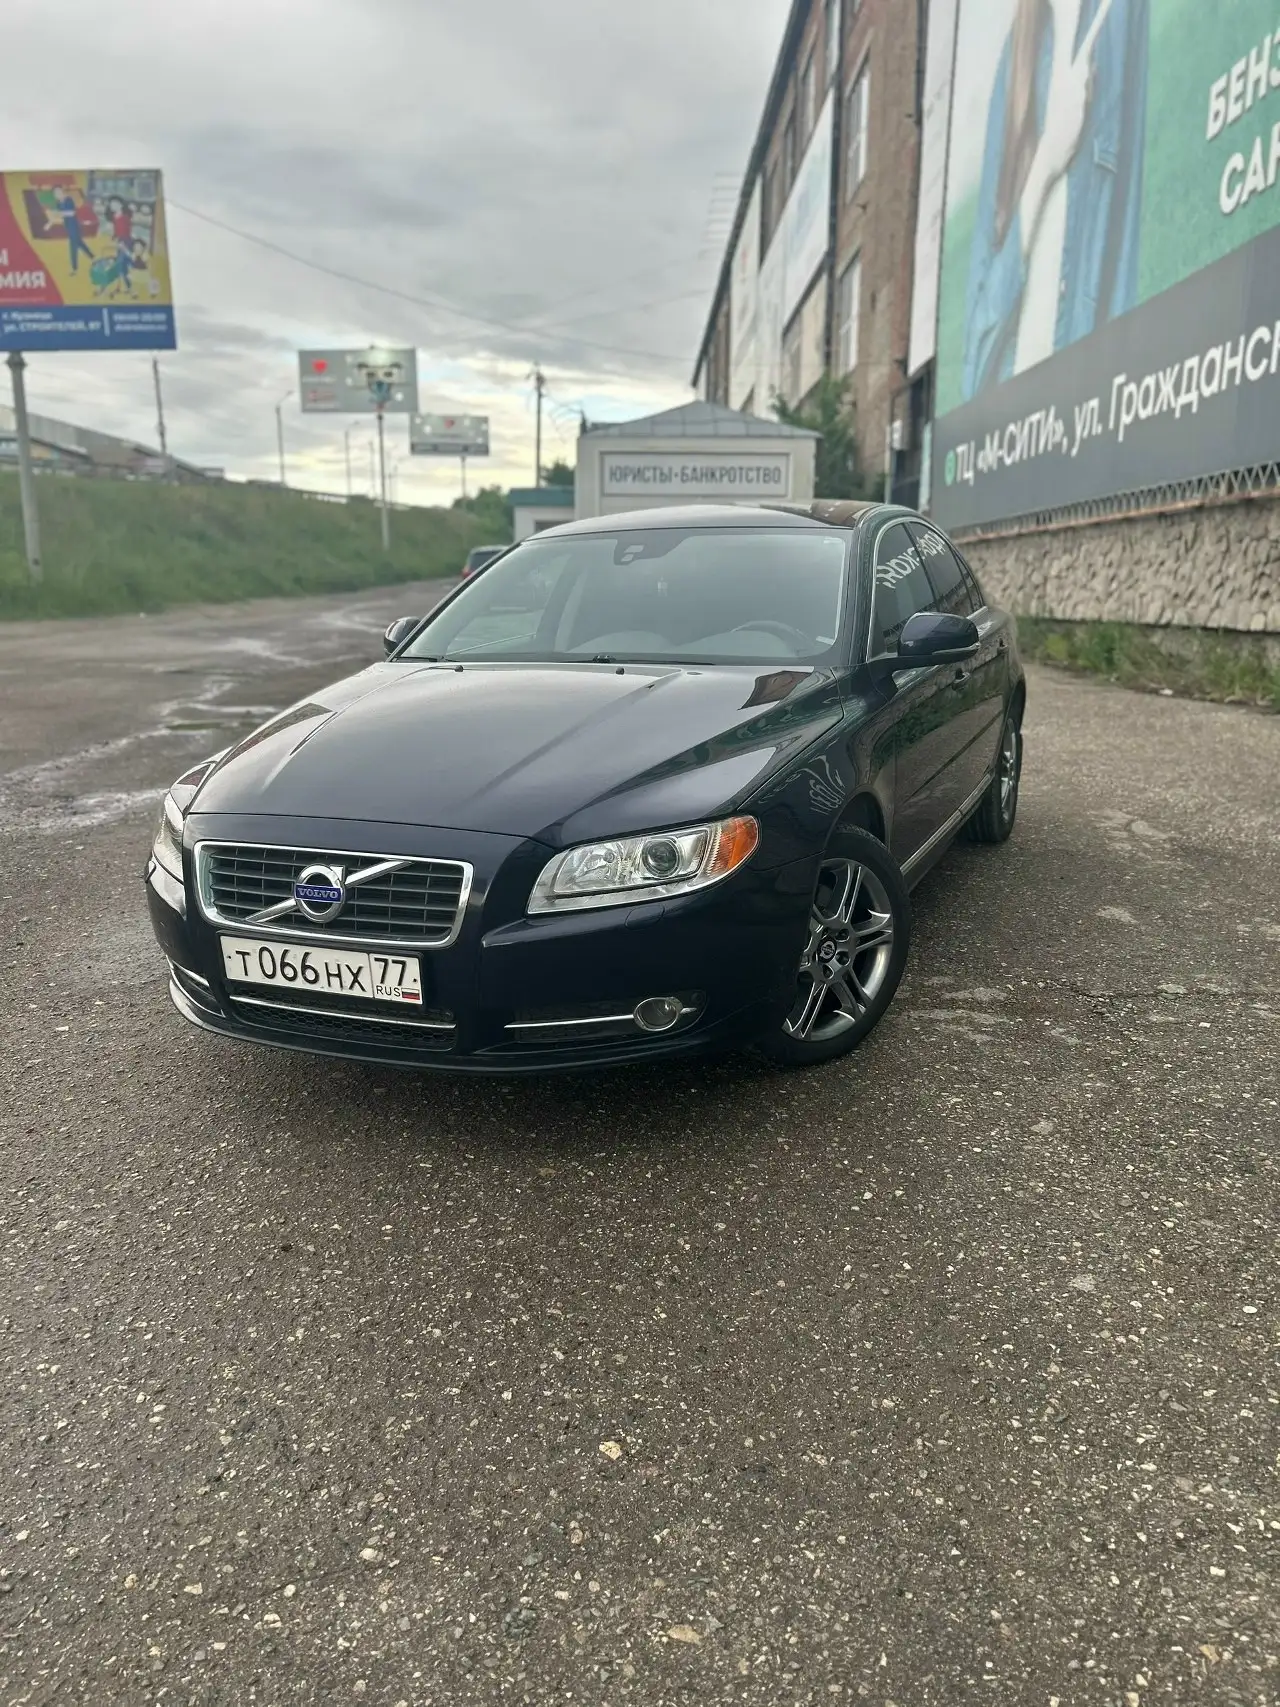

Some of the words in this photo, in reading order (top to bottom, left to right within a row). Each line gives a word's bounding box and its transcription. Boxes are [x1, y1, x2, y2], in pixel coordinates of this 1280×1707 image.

[955, 443, 975, 486] ТЦ
[976, 406, 1069, 475] «М-СИТИ»,
[1070, 397, 1104, 459] ул.
[298, 886, 339, 899] VOLVO
[374, 957, 408, 987] 77
[376, 985, 401, 998] RUS
